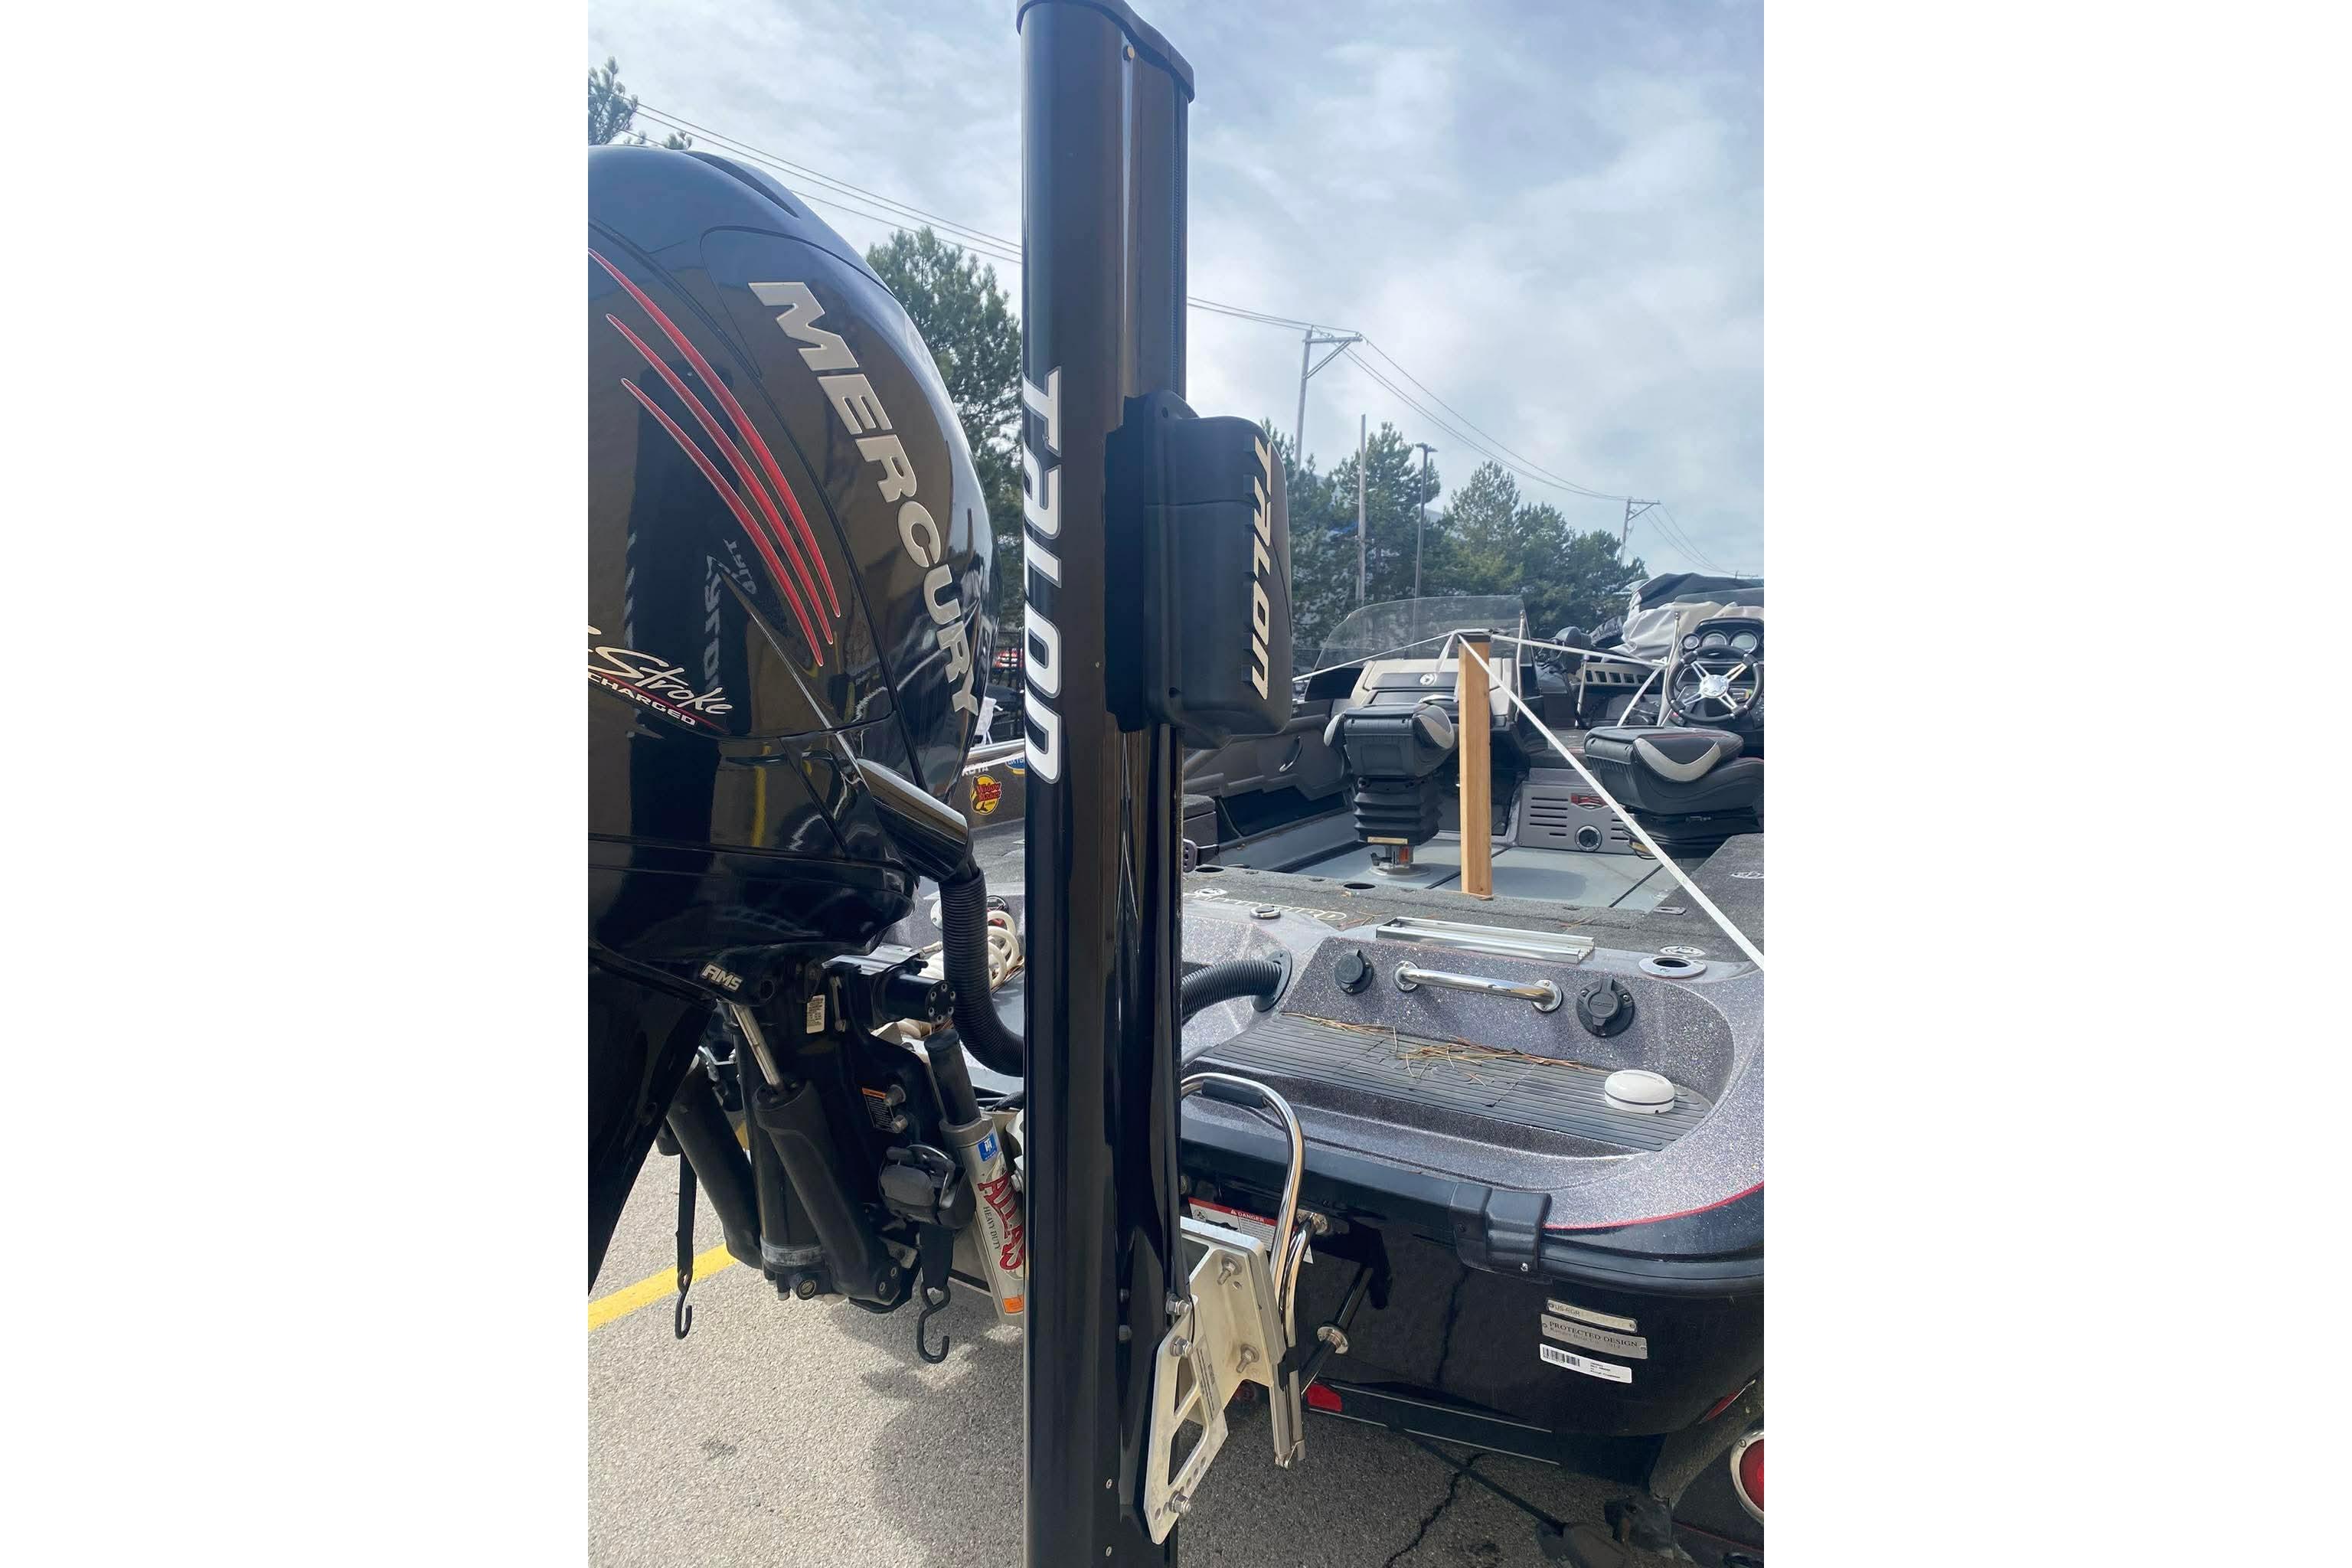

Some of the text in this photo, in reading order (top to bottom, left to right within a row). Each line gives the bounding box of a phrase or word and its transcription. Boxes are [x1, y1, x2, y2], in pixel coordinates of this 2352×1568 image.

[748, 282, 978, 717] MERCURY
[1023, 366, 1062, 785] TALON
[1252, 434, 1272, 701] TALON
[983, 1206, 1001, 1250] HEAVY DUTY
[1238, 1212, 1265, 1223] DANGER
[1550, 1321, 1601, 1341] PROTECTED
[1603, 1335, 1638, 1348] DESIGN
